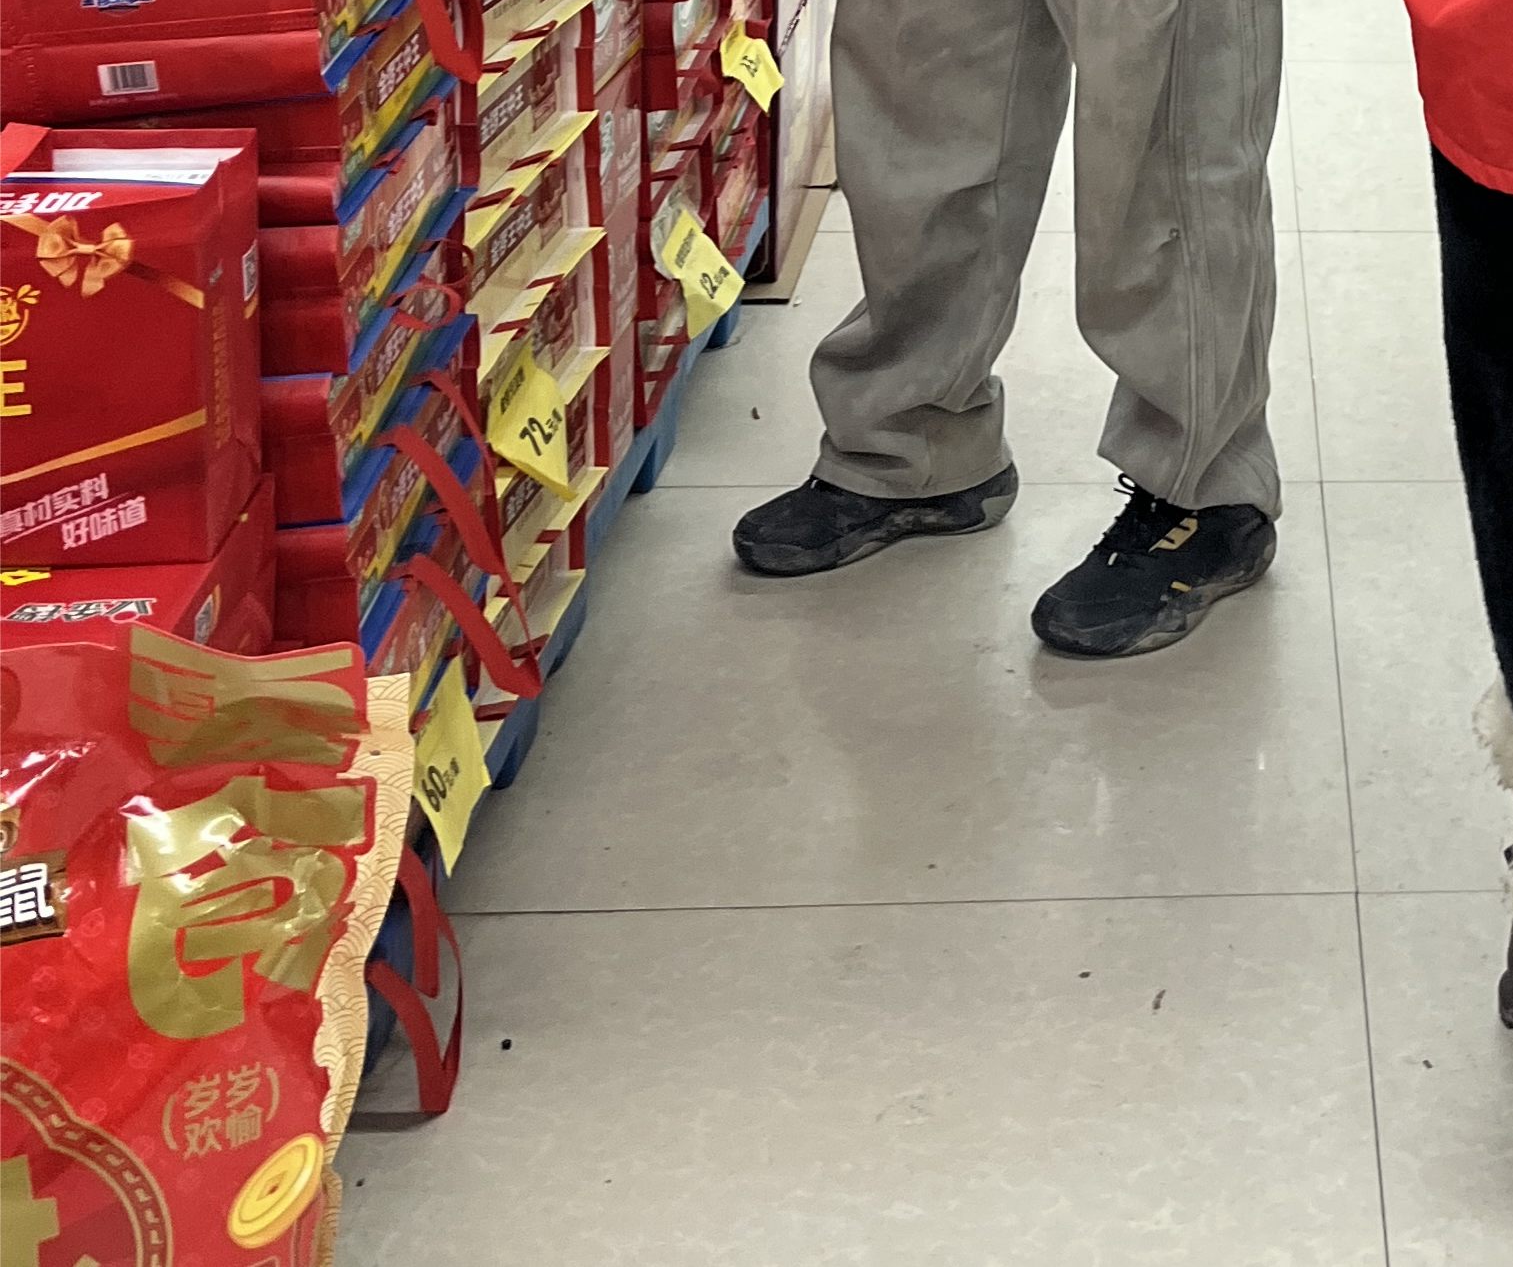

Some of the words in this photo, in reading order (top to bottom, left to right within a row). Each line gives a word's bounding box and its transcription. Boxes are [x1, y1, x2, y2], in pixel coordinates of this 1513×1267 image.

[0, 472, 109, 538] 真材实料
[61, 495, 147, 551] 好味道
